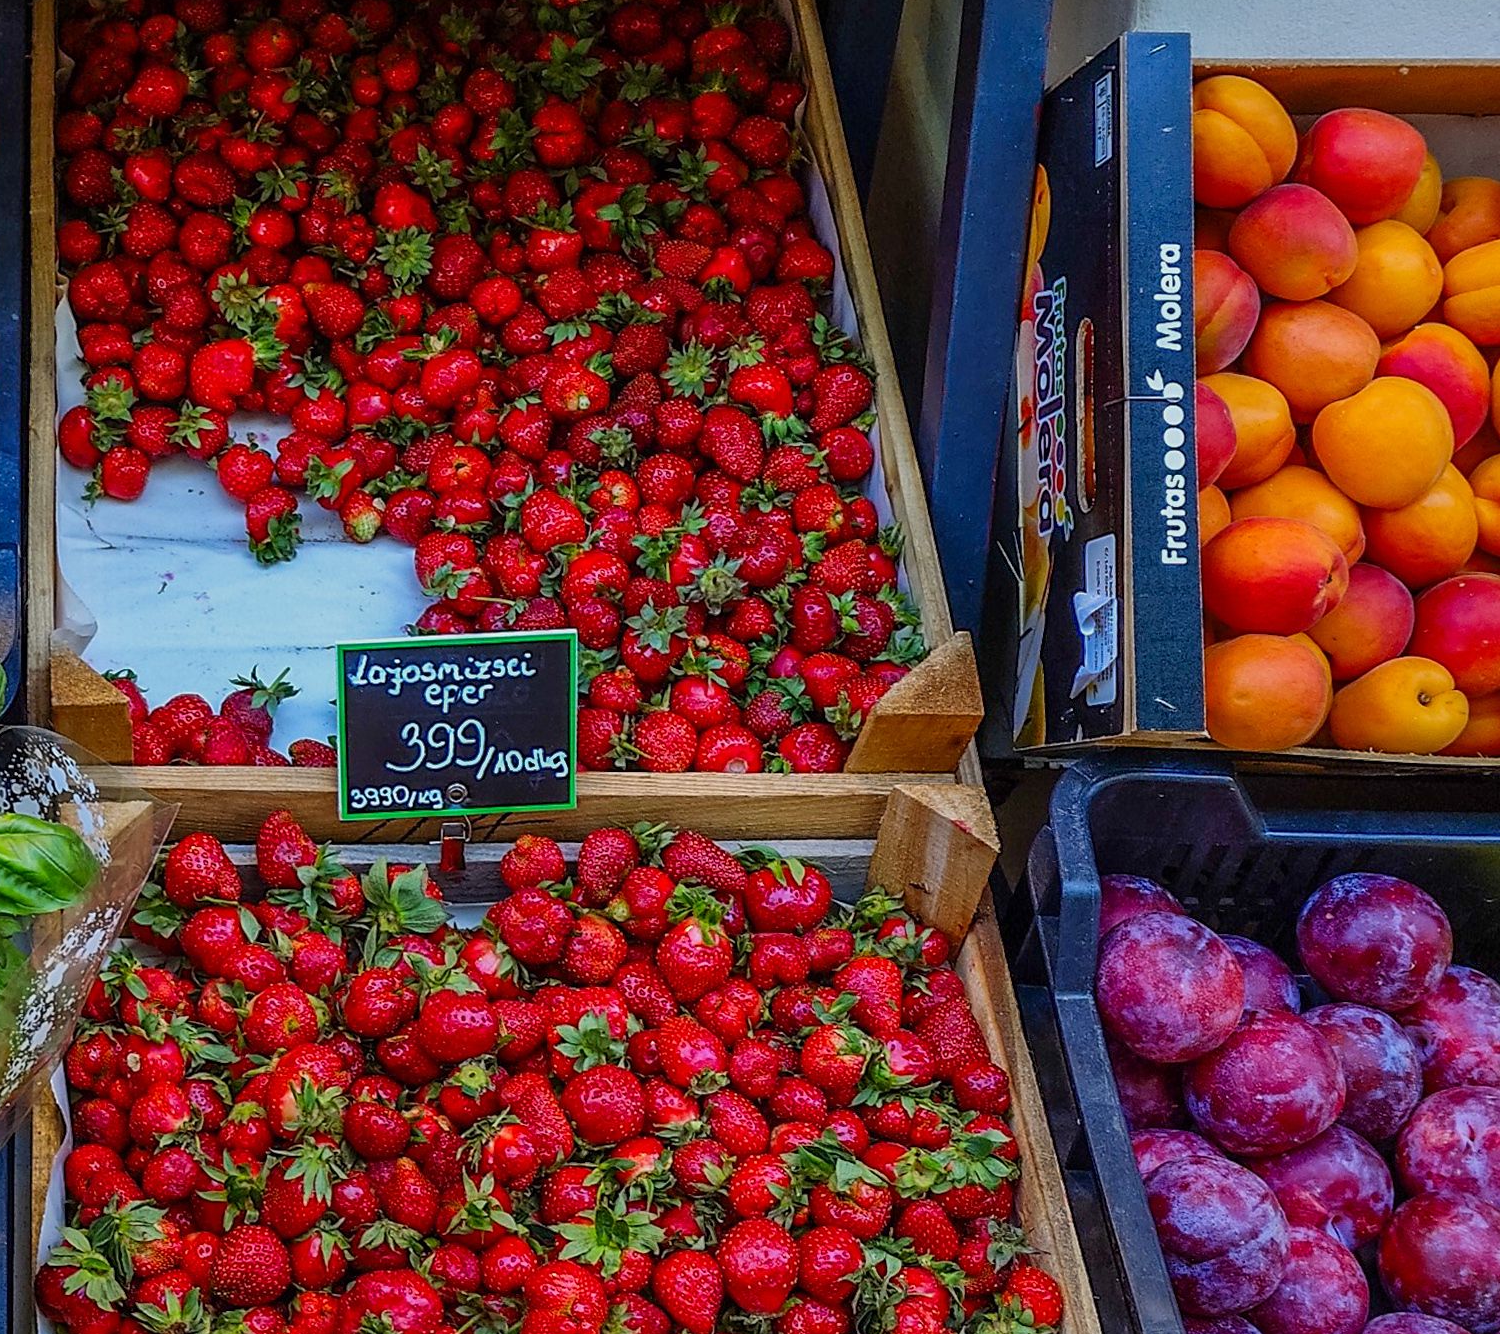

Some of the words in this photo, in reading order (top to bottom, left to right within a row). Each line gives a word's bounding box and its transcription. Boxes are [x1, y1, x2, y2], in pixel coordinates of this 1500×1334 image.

[1053, 276, 1067, 396] Frutas
[1153, 243, 1182, 351] Molera
[1033, 290, 1065, 537] Molera
[1161, 474, 1187, 564] Frutas
[424, 682, 495, 714] eper
[350, 784, 444, 810] 3990/kg
